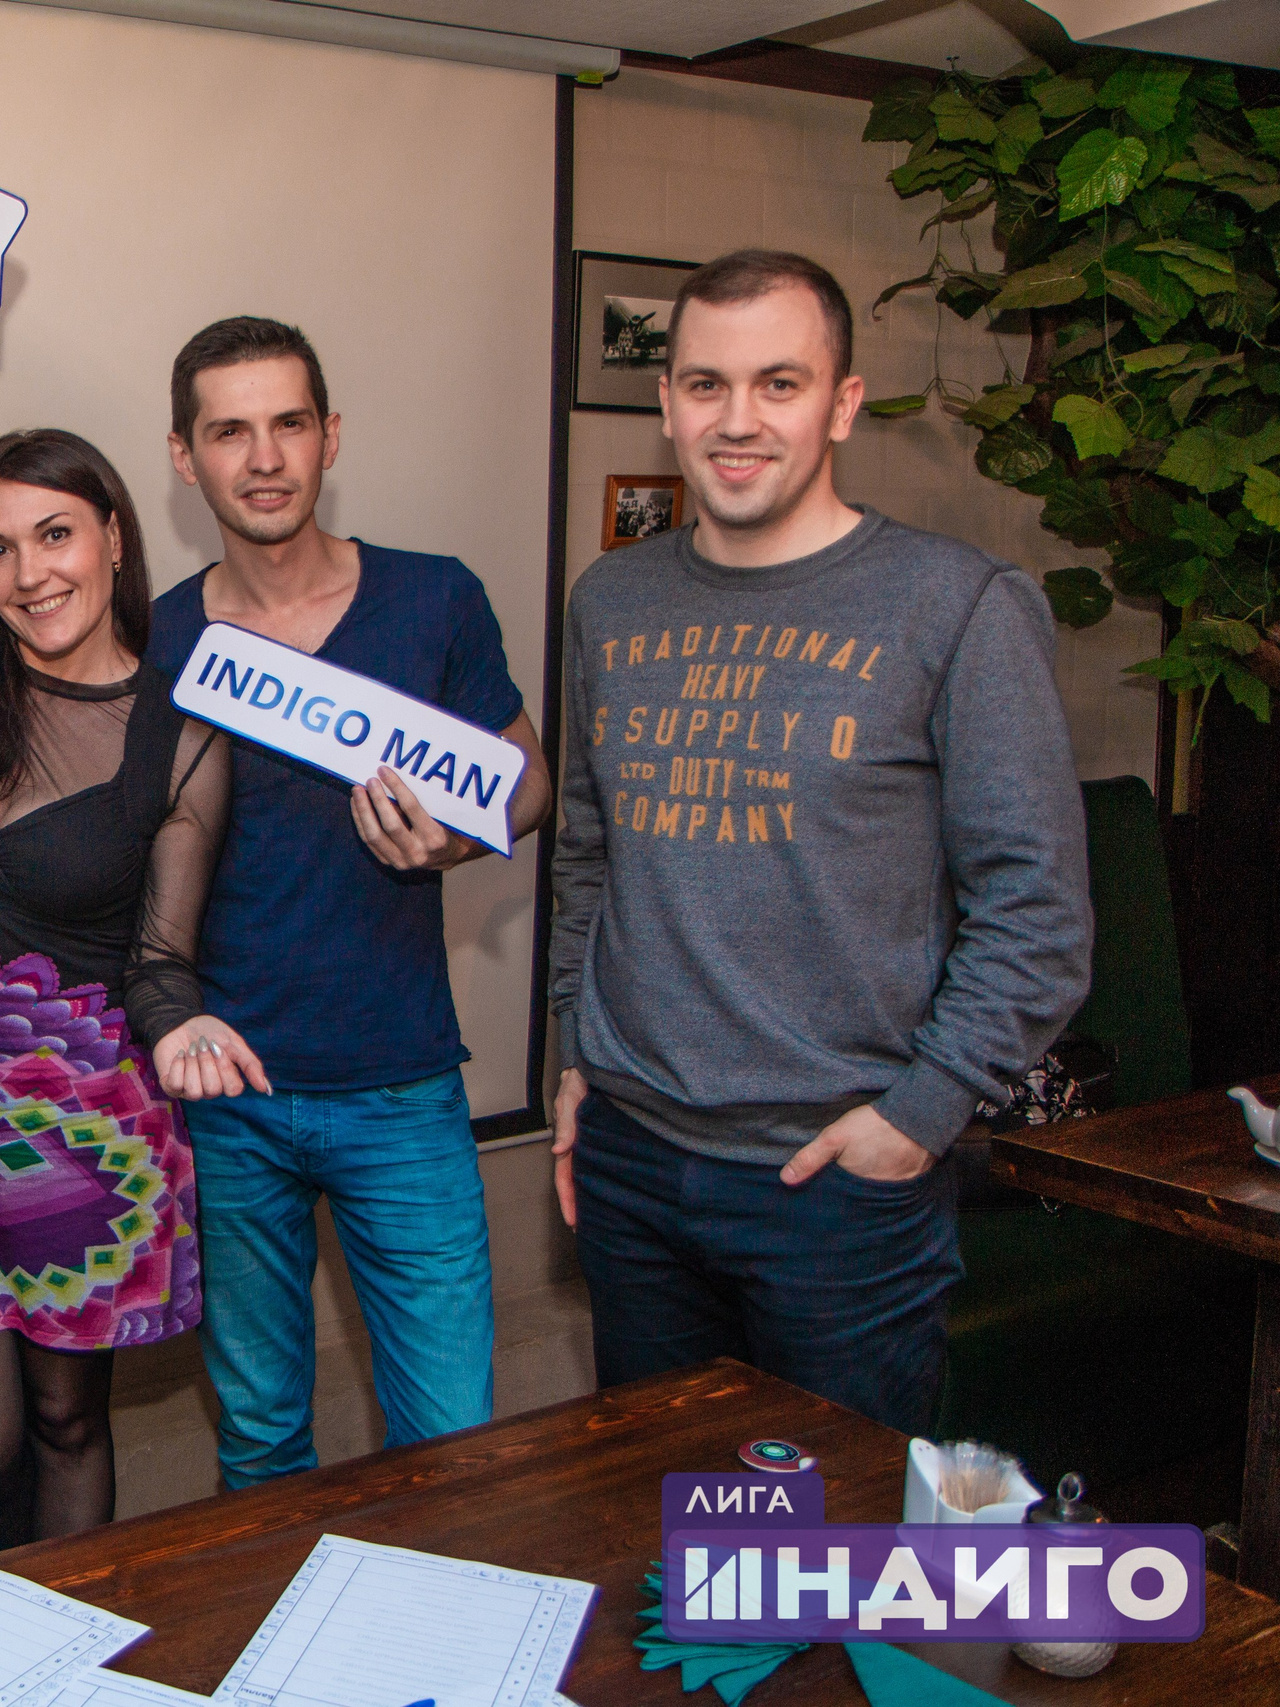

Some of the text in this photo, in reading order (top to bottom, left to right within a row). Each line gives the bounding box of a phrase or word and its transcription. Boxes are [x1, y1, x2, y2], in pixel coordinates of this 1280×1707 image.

[602, 624, 882, 681] TRADITIONAL
[680, 664, 766, 700] HEAVY
[196, 652, 502, 810] INDIGO MAN
[625, 706, 801, 751] SUPPLY
[620, 756, 790, 798] LTD DUTY TRM
[614, 791, 795, 843] COMPANY
